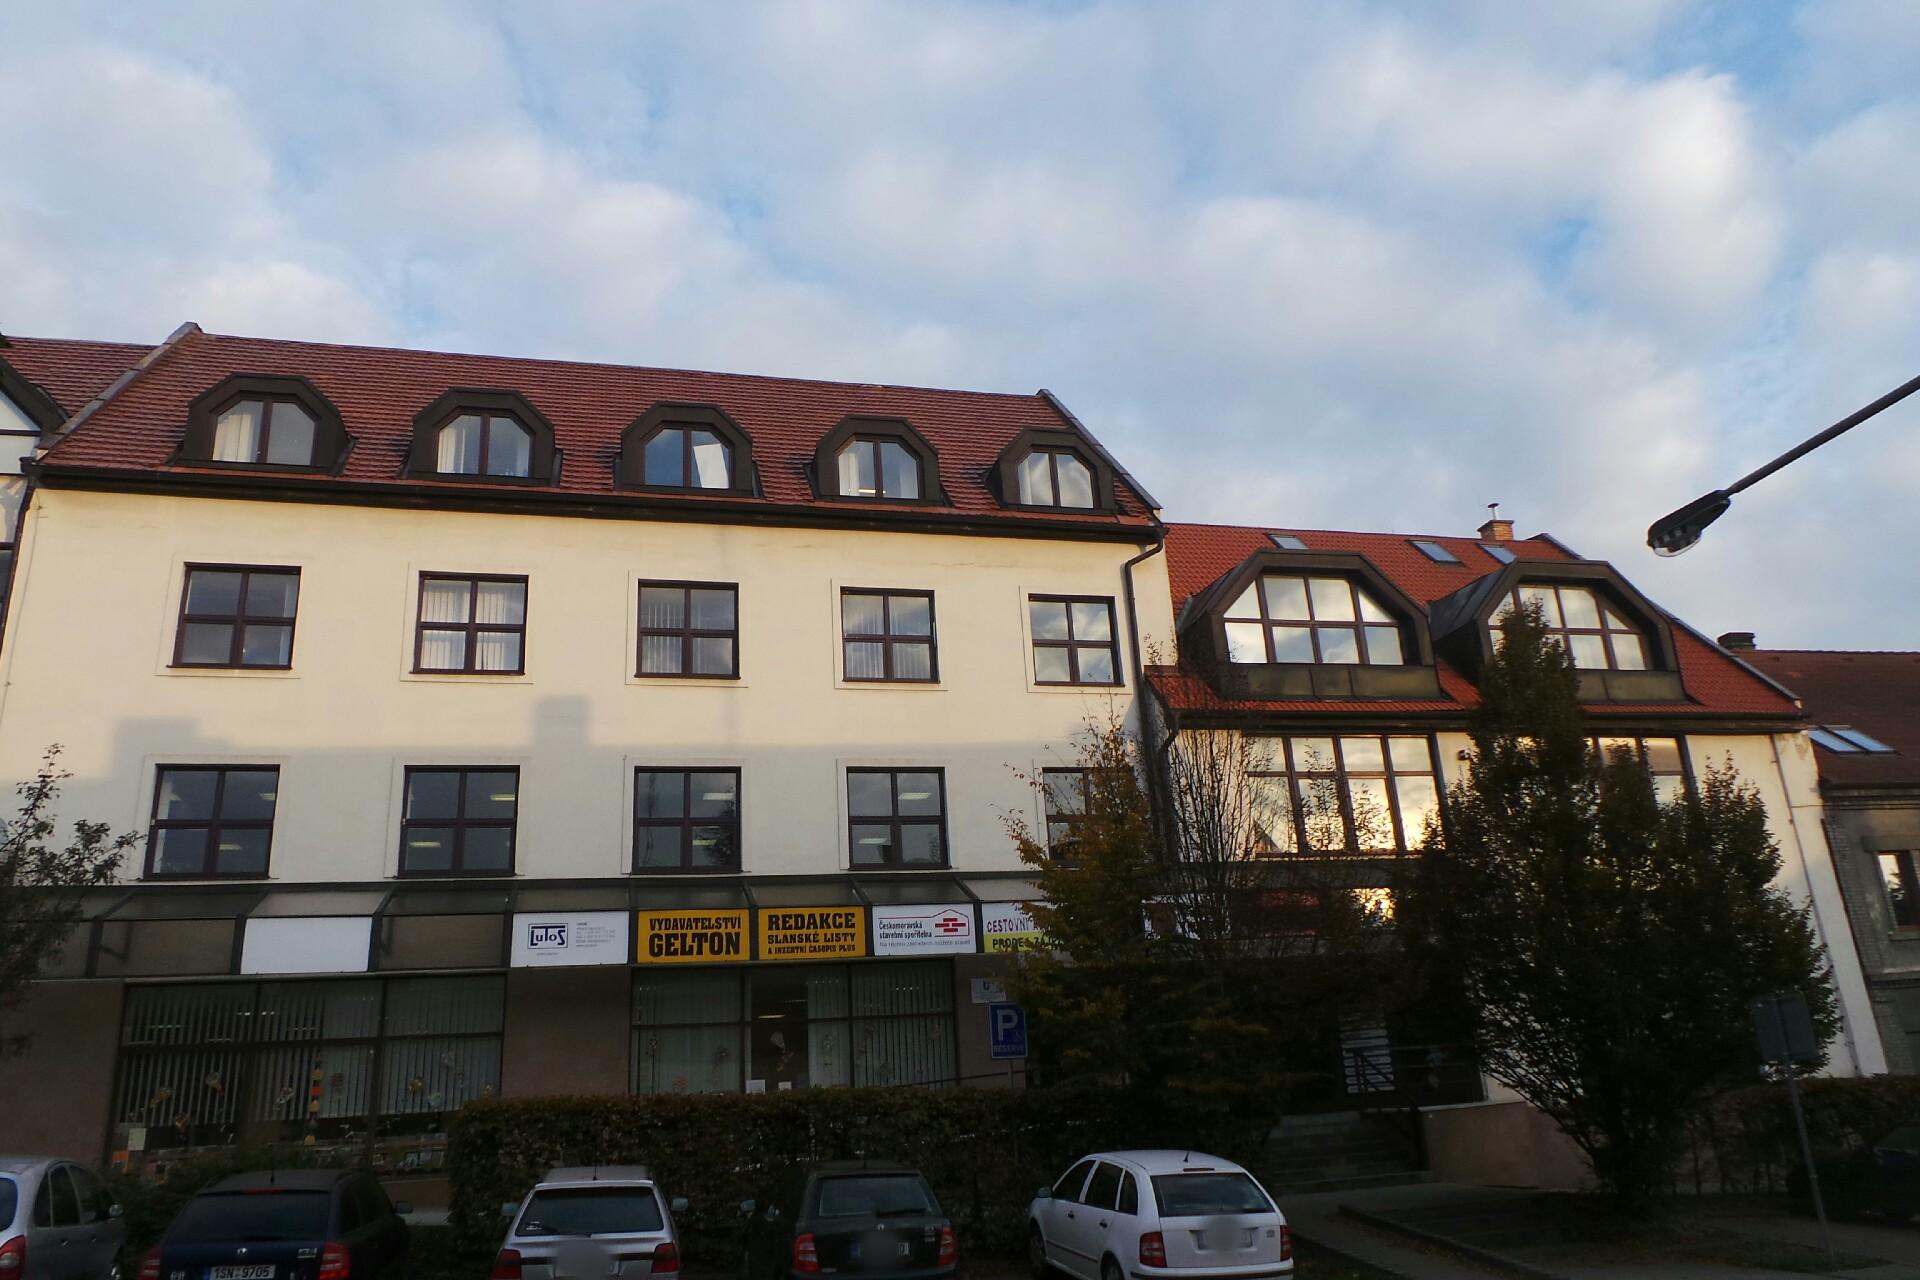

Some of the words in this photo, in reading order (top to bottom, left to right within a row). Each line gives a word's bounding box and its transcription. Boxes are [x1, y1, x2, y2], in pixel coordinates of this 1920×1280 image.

[649, 914, 742, 931] VYDAVATELSTVÍ
[768, 912, 856, 931] REDAKCE
[879, 920, 923, 930] Českomoravská
[768, 931, 820, 945] SLÁNSKÉ
[823, 932, 856, 943] LISTY
[880, 930, 904, 939] stavební
[904, 930, 932, 940] spořitelna
[648, 931, 741, 958] GELTON
[768, 947, 773, 955] A
[809, 944, 837, 954] ČASOPIS
[996, 1009, 1018, 1041] P
[241, 1266, 270, 1278] 9705
